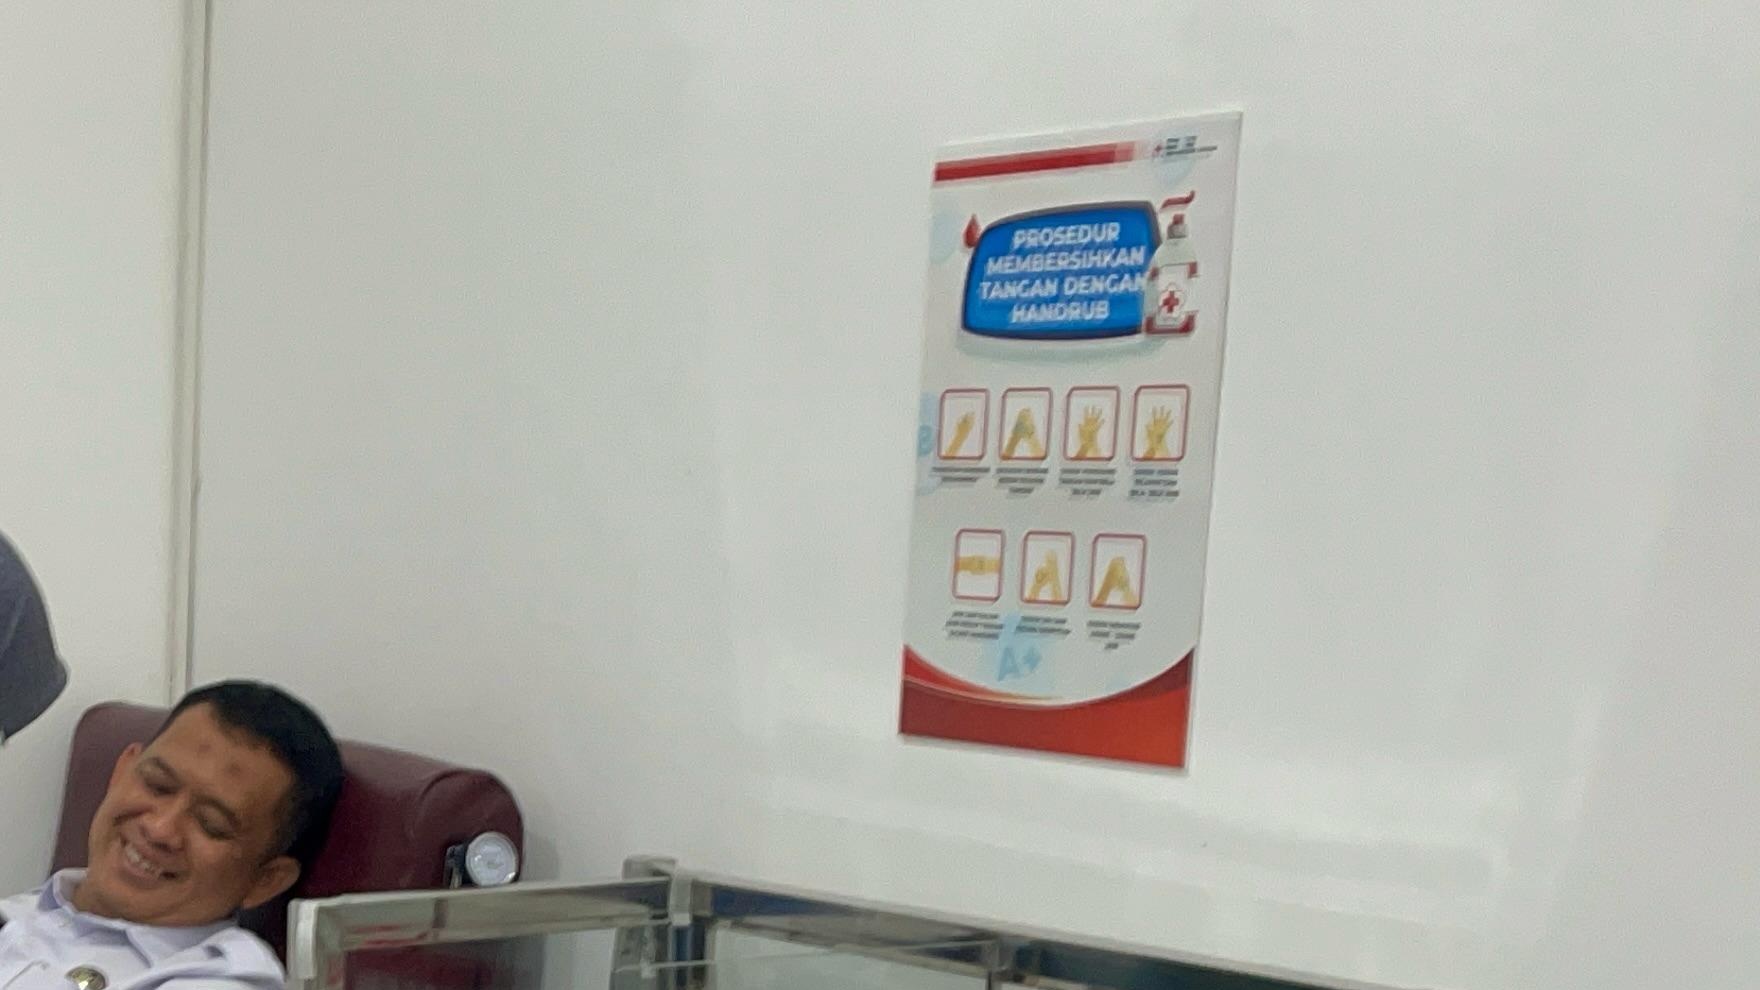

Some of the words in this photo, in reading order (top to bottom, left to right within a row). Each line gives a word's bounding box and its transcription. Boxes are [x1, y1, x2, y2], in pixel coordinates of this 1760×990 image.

[1012, 222, 1120, 249] PROSEDUR
[986, 246, 1145, 274] MEMBERSIHKAN
[980, 278, 1058, 299] TANGAN
[1064, 273, 1145, 296] DENGAN
[1012, 301, 1110, 323] HANDRUB
